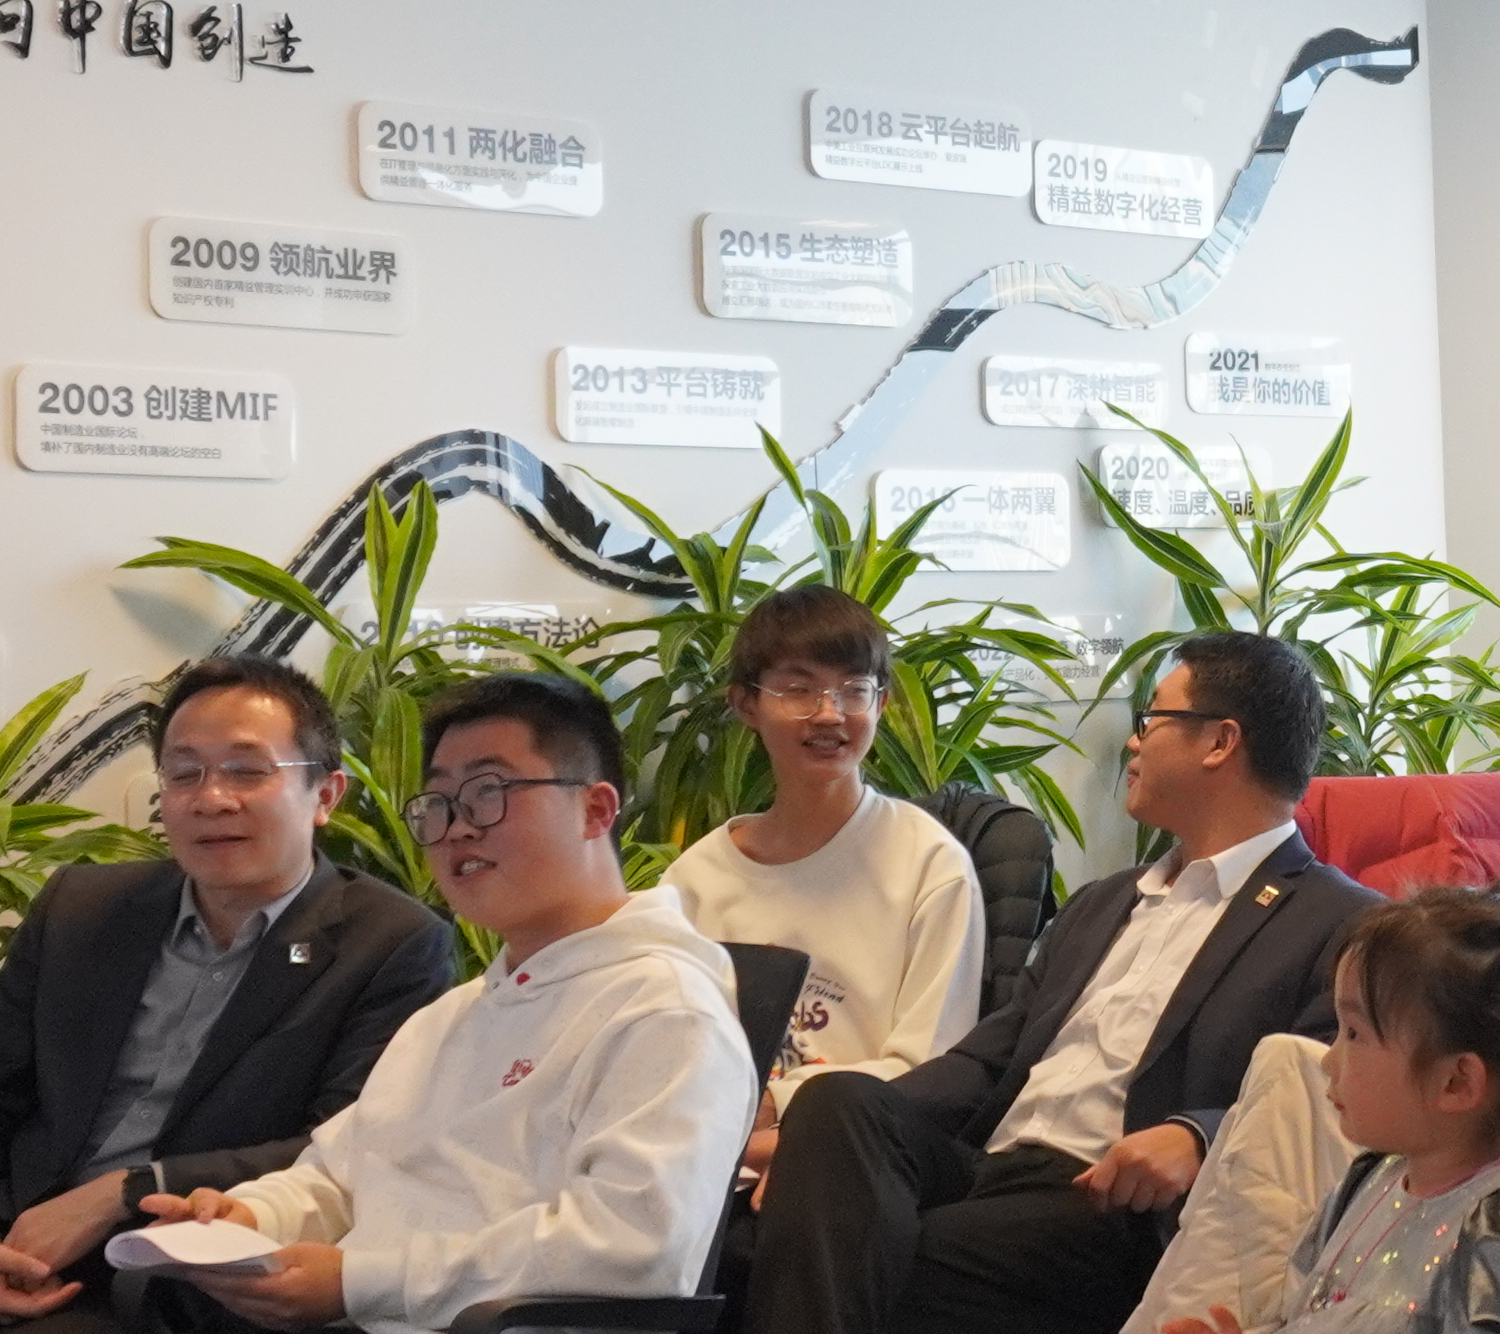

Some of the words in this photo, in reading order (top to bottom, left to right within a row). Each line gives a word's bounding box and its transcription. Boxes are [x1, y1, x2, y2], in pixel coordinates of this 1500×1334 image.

[377, 120, 457, 156] 2011
[467, 124, 585, 169] 两化融合
[825, 105, 892, 138] 2018
[900, 112, 1021, 152] 云平台起航
[1047, 153, 1108, 183] 2019
[1047, 183, 1203, 226] 精益数字化经营
[170, 235, 260, 272] 2009
[268, 240, 399, 285] 领航业界
[719, 229, 792, 260] 2015
[799, 232, 899, 269] 生态塑造
[1209, 348, 1260, 372] 2021
[572, 364, 648, 394] 2013
[656, 366, 765, 401] 平台铸就
[999, 371, 1059, 398] 2017
[1066, 373, 1156, 403] 深耕智能
[1209, 375, 1331, 406] 我是你的价值
[38, 382, 134, 418] 2003
[143, 385, 278, 422] 创建MIF
[1111, 456, 1170, 481] 2020
[963, 485, 1057, 515] 一体两翼
